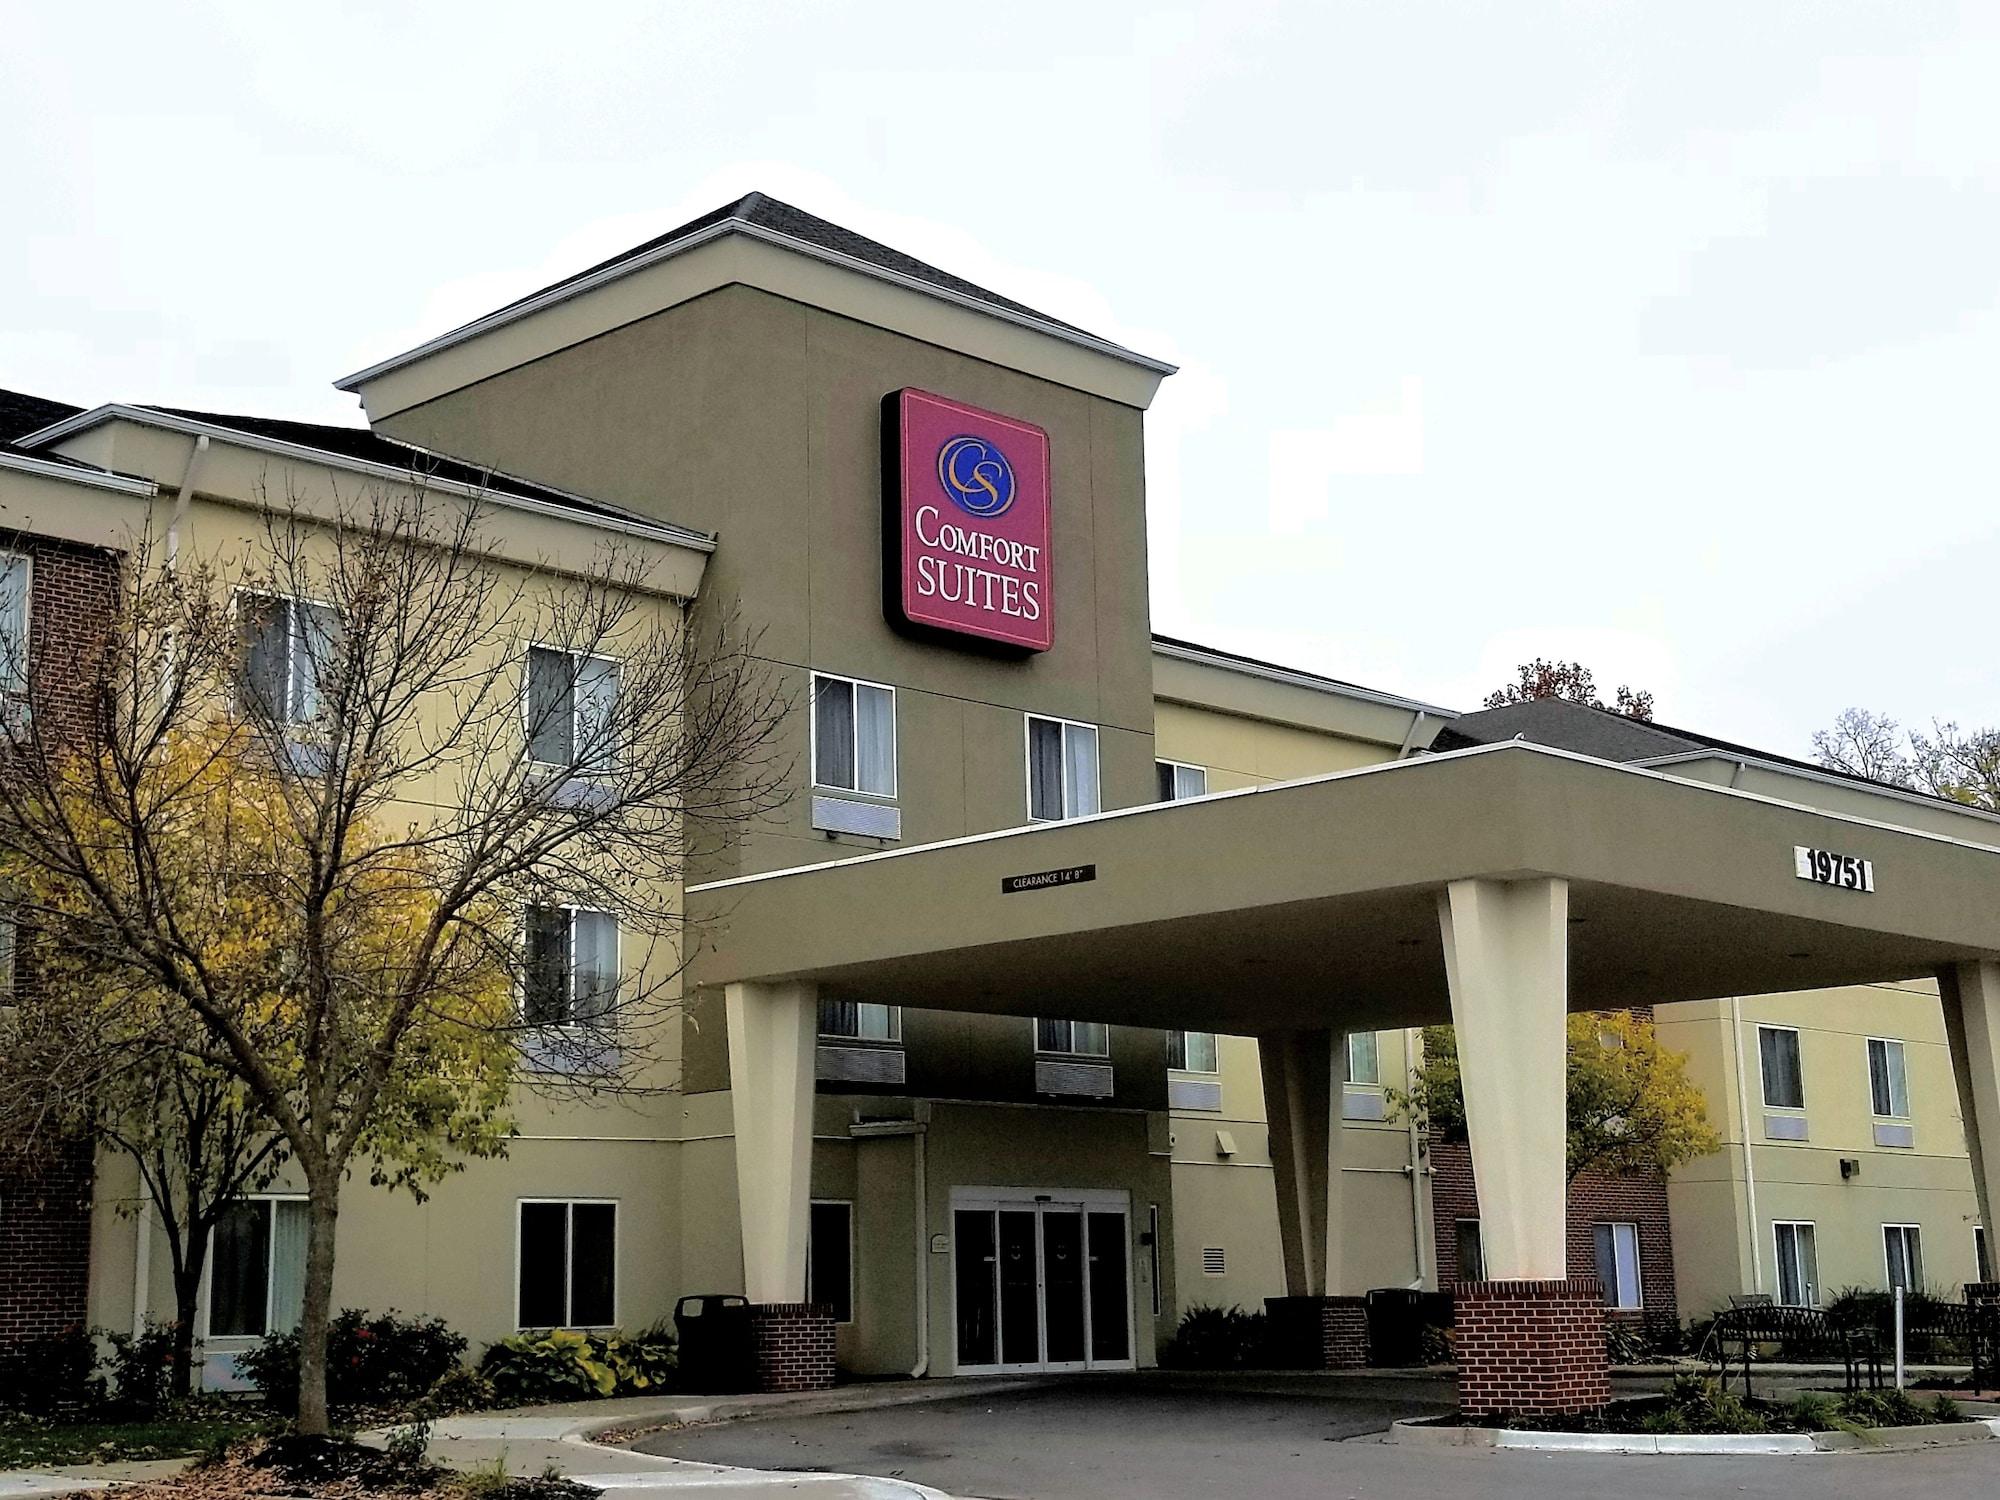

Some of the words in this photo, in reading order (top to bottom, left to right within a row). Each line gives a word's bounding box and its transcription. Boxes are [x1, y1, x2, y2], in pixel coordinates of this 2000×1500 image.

[917, 555, 1040, 621] SUITES
[1013, 873, 1058, 888] CLEARANCE
[1807, 849, 1866, 890] 19751
